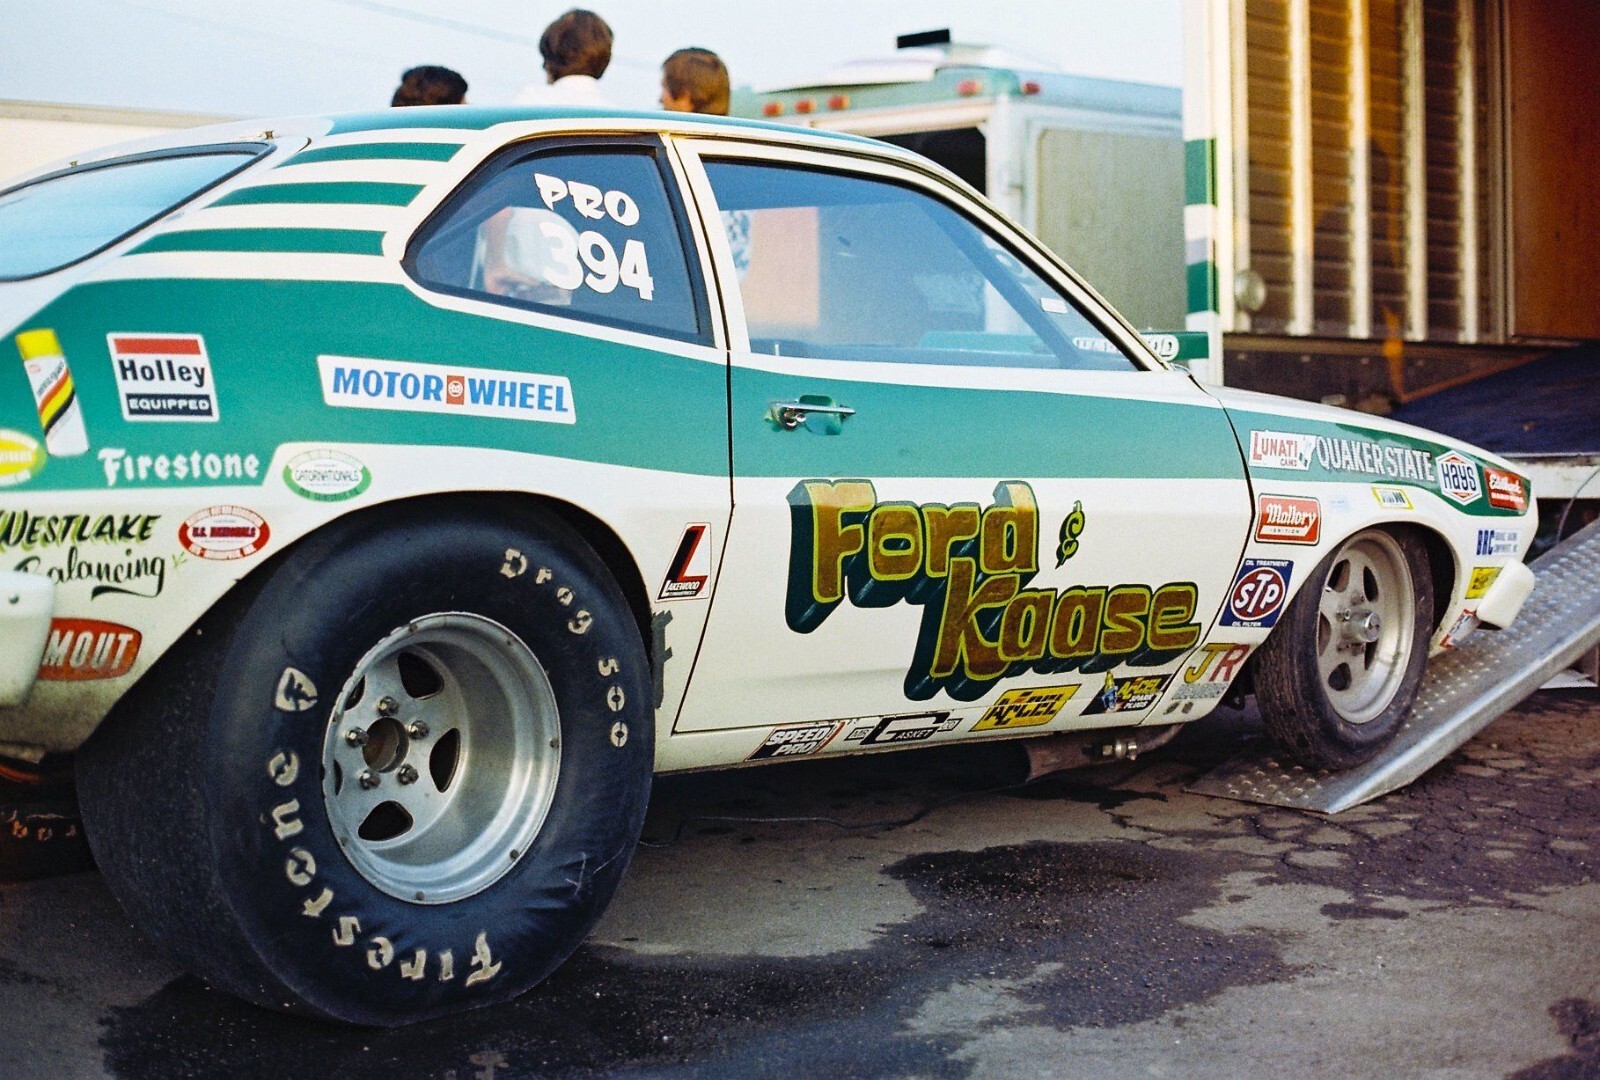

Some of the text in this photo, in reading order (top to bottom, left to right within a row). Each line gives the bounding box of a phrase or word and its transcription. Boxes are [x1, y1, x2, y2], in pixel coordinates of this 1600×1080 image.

[534, 173, 640, 226] PRO
[539, 230, 655, 301] 394
[118, 360, 206, 388] Holley
[332, 367, 568, 412] MOTOR WHEEL
[128, 397, 211, 411] EQUIPPED
[1253, 432, 1297, 460] LUNATI
[1316, 435, 1435, 481] QUAKER STATE
[98, 447, 260, 487] Firestone
[0, 510, 160, 549] WESTLAKE
[1265, 502, 1317, 526] Mallory
[795, 479, 1039, 616] Ford
[1235, 573, 1280, 614] STP
[918, 556, 1199, 691] Kaase
[500, 549, 628, 748] Drag 500
[1183, 642, 1251, 684] JR
[984, 691, 1064, 726] ACCEL
[765, 727, 831, 746] SPEED
[771, 741, 818, 756] PRO
[268, 751, 502, 987] Firestone
